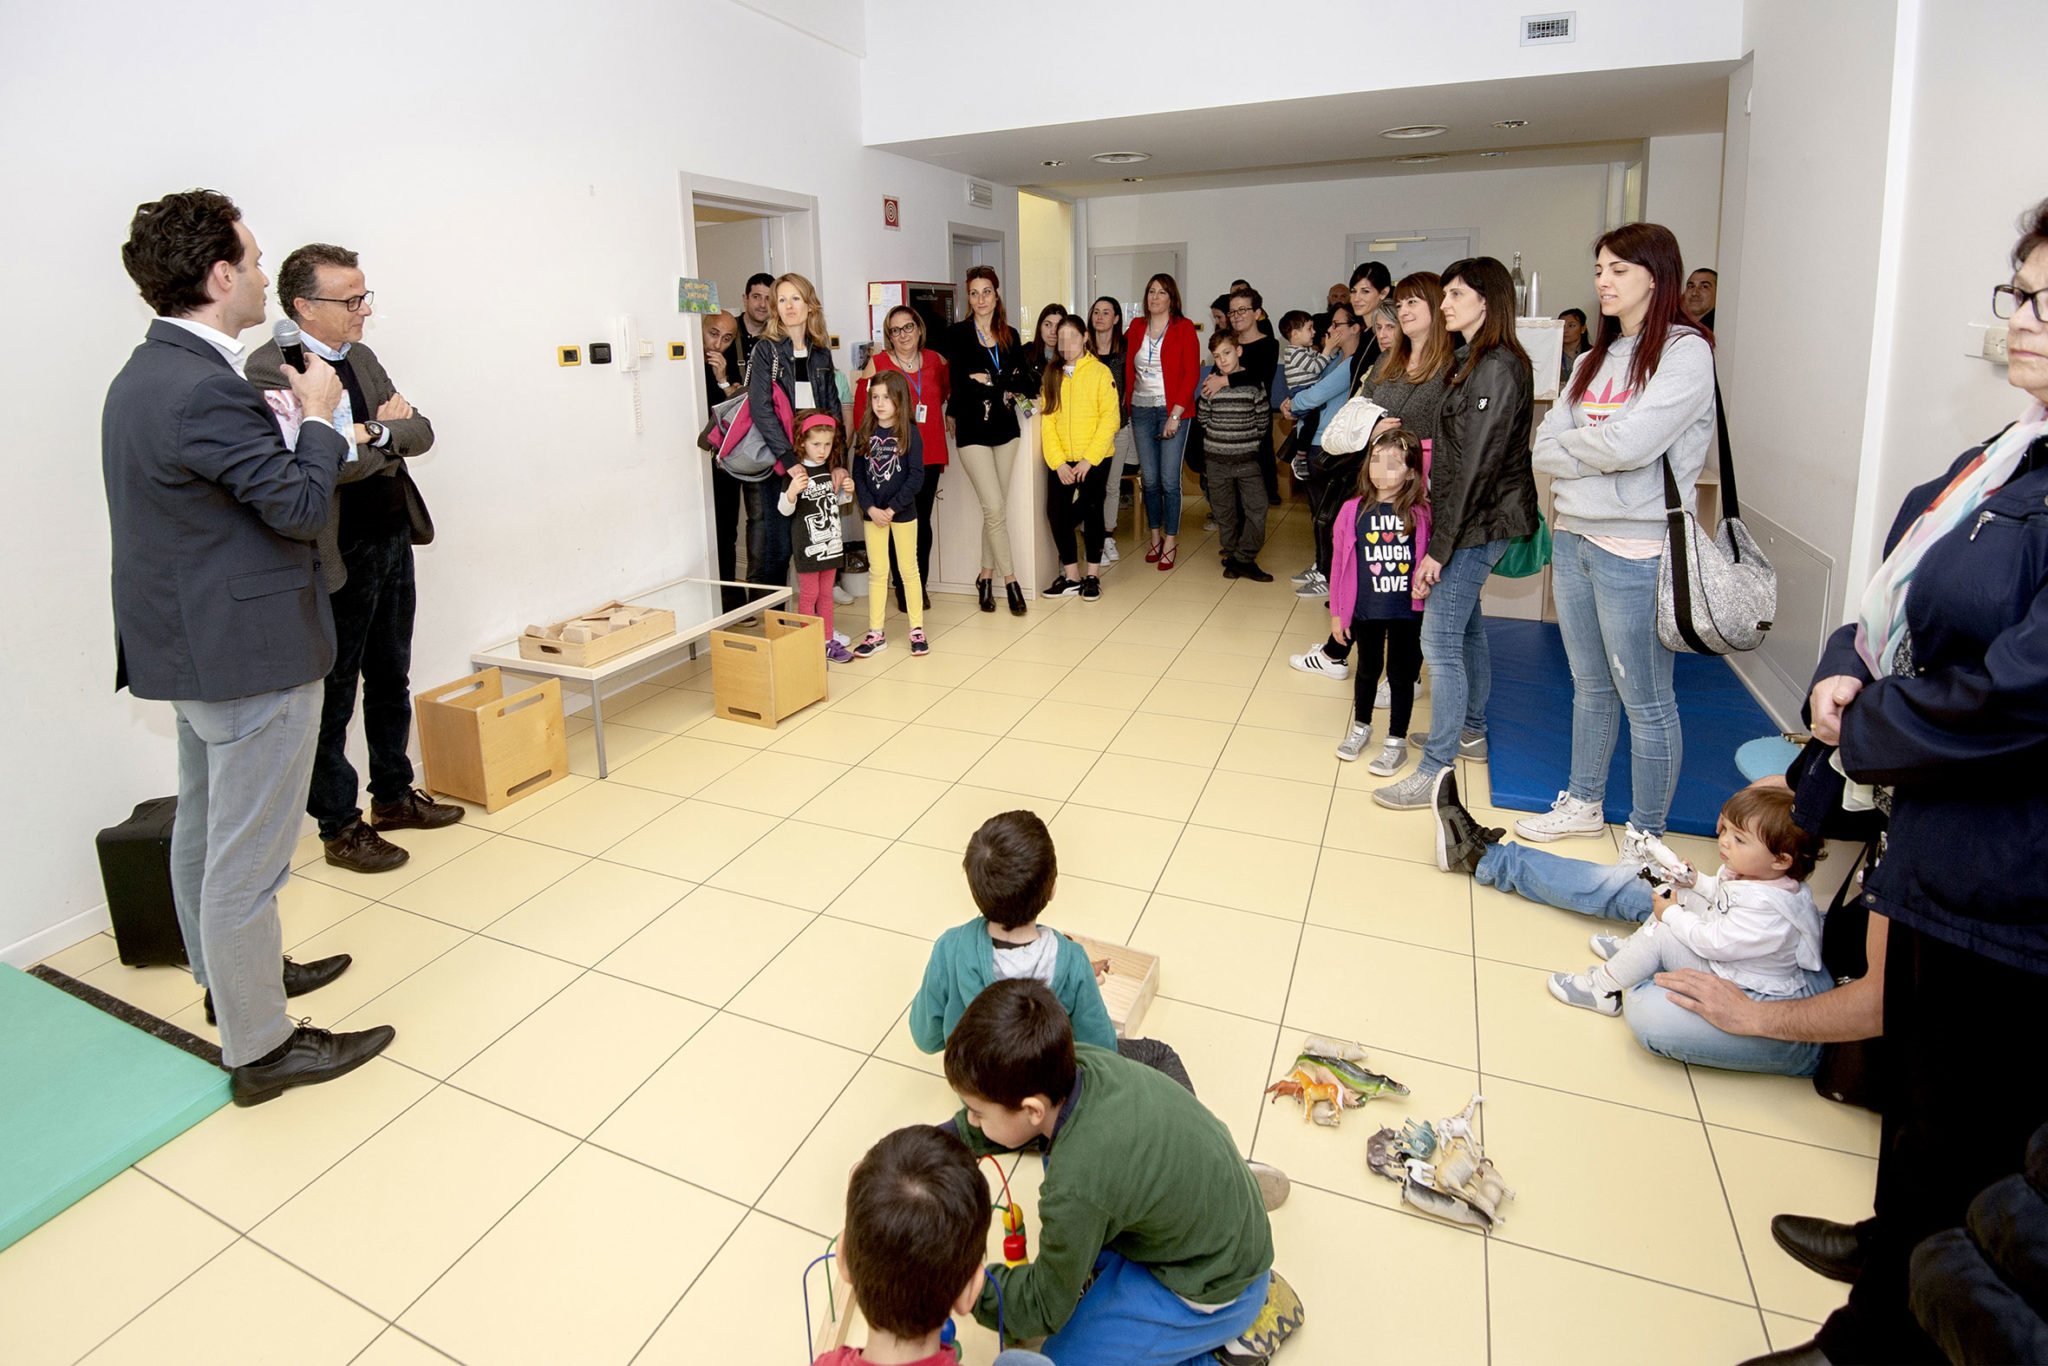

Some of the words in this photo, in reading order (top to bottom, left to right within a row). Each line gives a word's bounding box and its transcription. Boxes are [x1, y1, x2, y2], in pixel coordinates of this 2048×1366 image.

[1370, 515, 1405, 531] LIVE
[1364, 544, 1411, 562] LAUGH
[1372, 576, 1408, 593] LOVE
